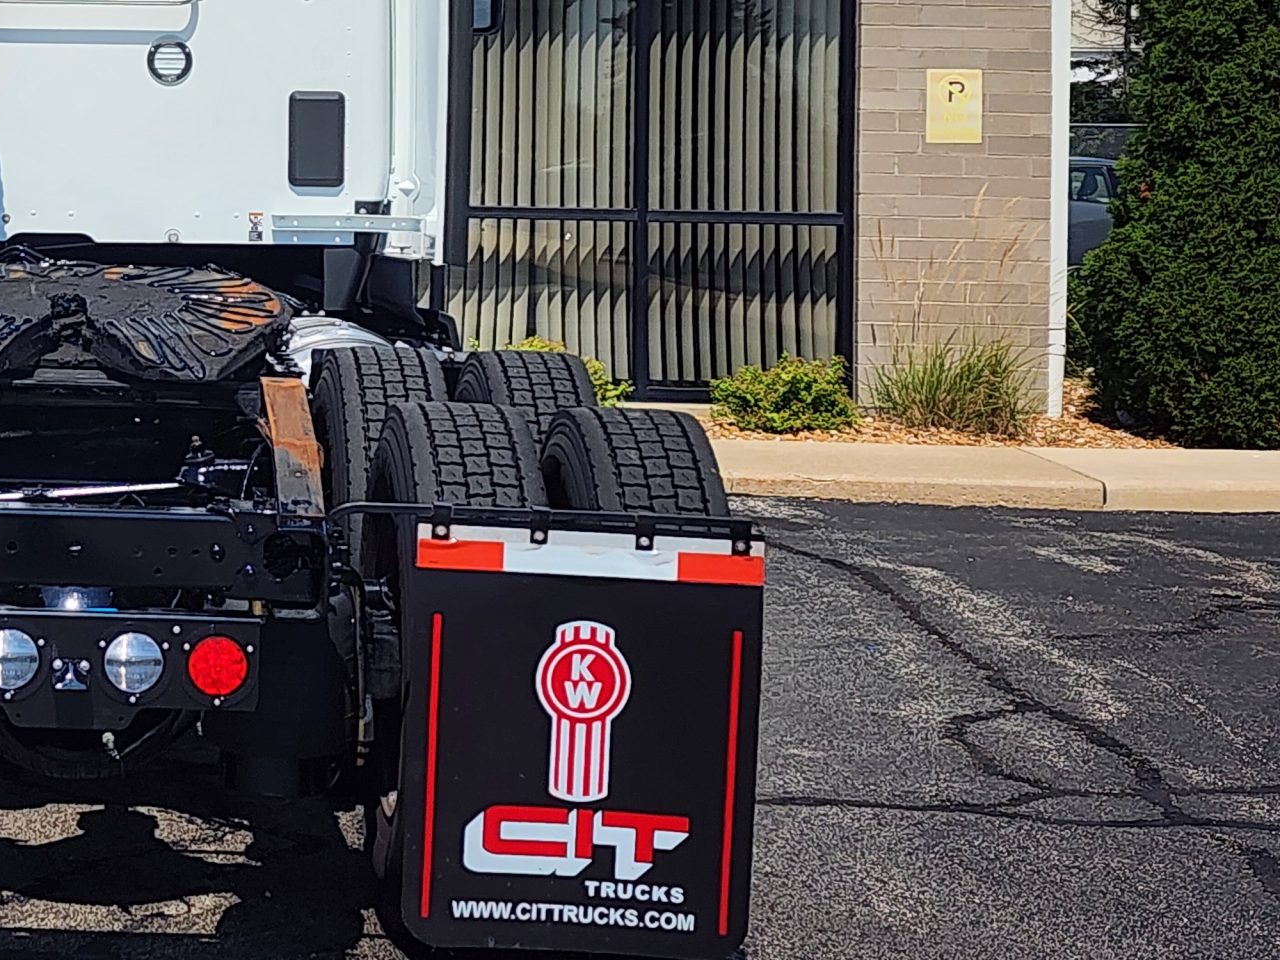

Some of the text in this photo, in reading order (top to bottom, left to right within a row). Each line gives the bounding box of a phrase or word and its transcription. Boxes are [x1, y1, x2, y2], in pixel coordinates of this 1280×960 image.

[463, 805, 690, 881] CIT
[584, 880, 685, 903] TRUCKS
[452, 900, 696, 932] WWW.CITTRUCKS.COM
